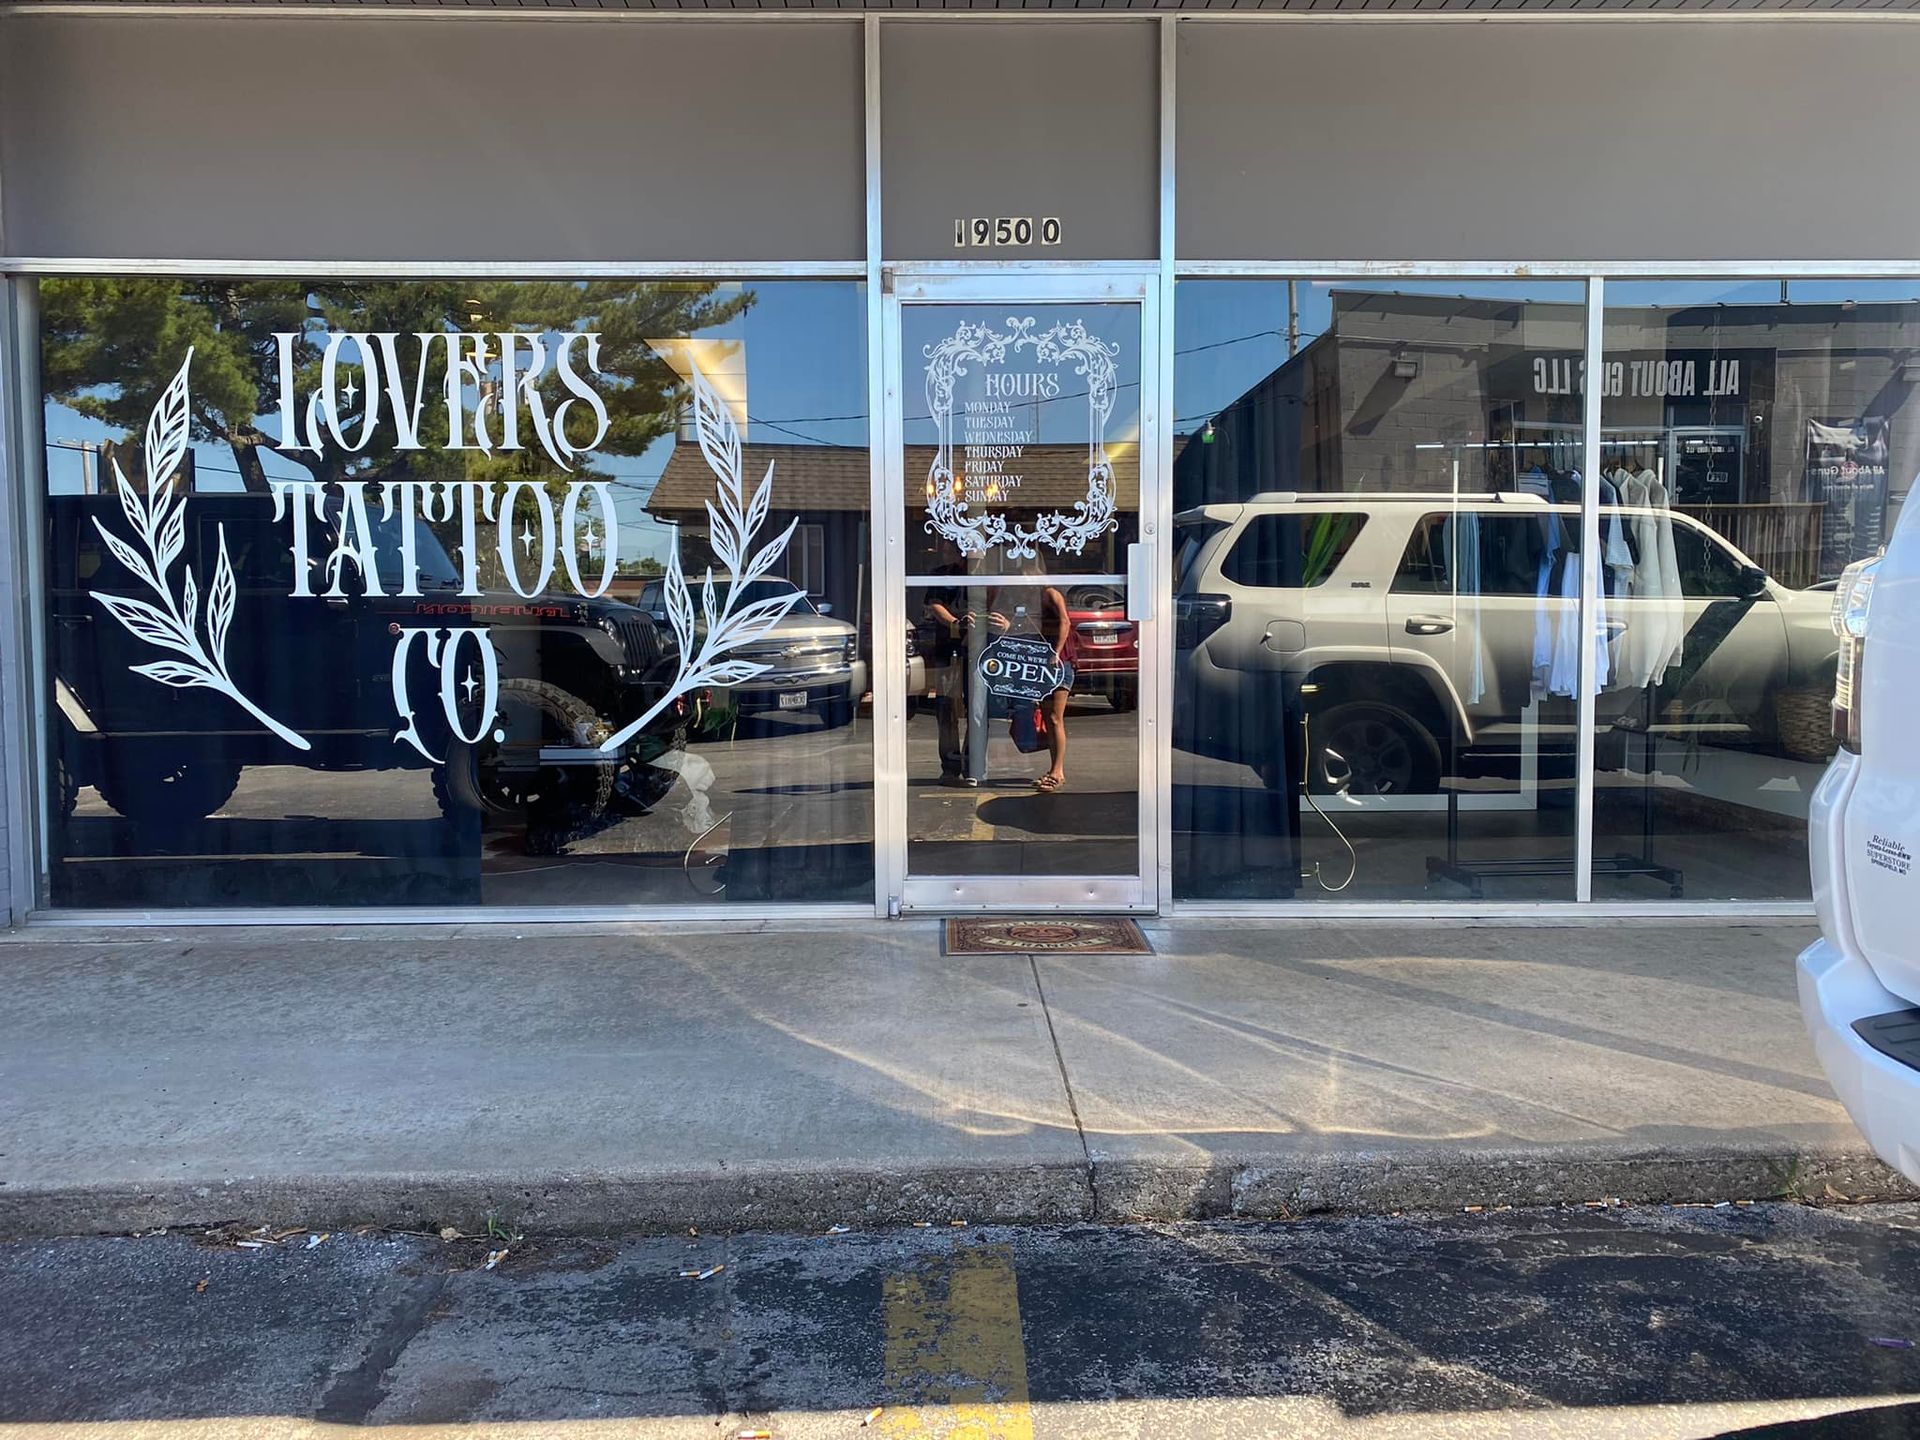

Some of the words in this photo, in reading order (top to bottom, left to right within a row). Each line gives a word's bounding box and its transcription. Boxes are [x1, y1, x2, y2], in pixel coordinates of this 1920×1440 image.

[985, 373, 1060, 400] HOURS
[271, 333, 611, 472] LOVERS
[965, 401, 1012, 414] MONDAY
[965, 416, 1015, 429] TUESDAY
[965, 430, 1033, 444] WEDNESDAY
[965, 445, 1024, 459] THURSDAY
[965, 461, 1005, 474] FRIDAY
[965, 475, 1023, 489] SATURDAY
[271, 481, 620, 598] TATTOO
[996, 651, 1017, 660] COME
[983, 658, 1060, 686] OPEN
[392, 627, 505, 764] CO.
[1873, 834, 1905, 851] Reliable
[1867, 849, 1911, 871] SUPERSTORE
